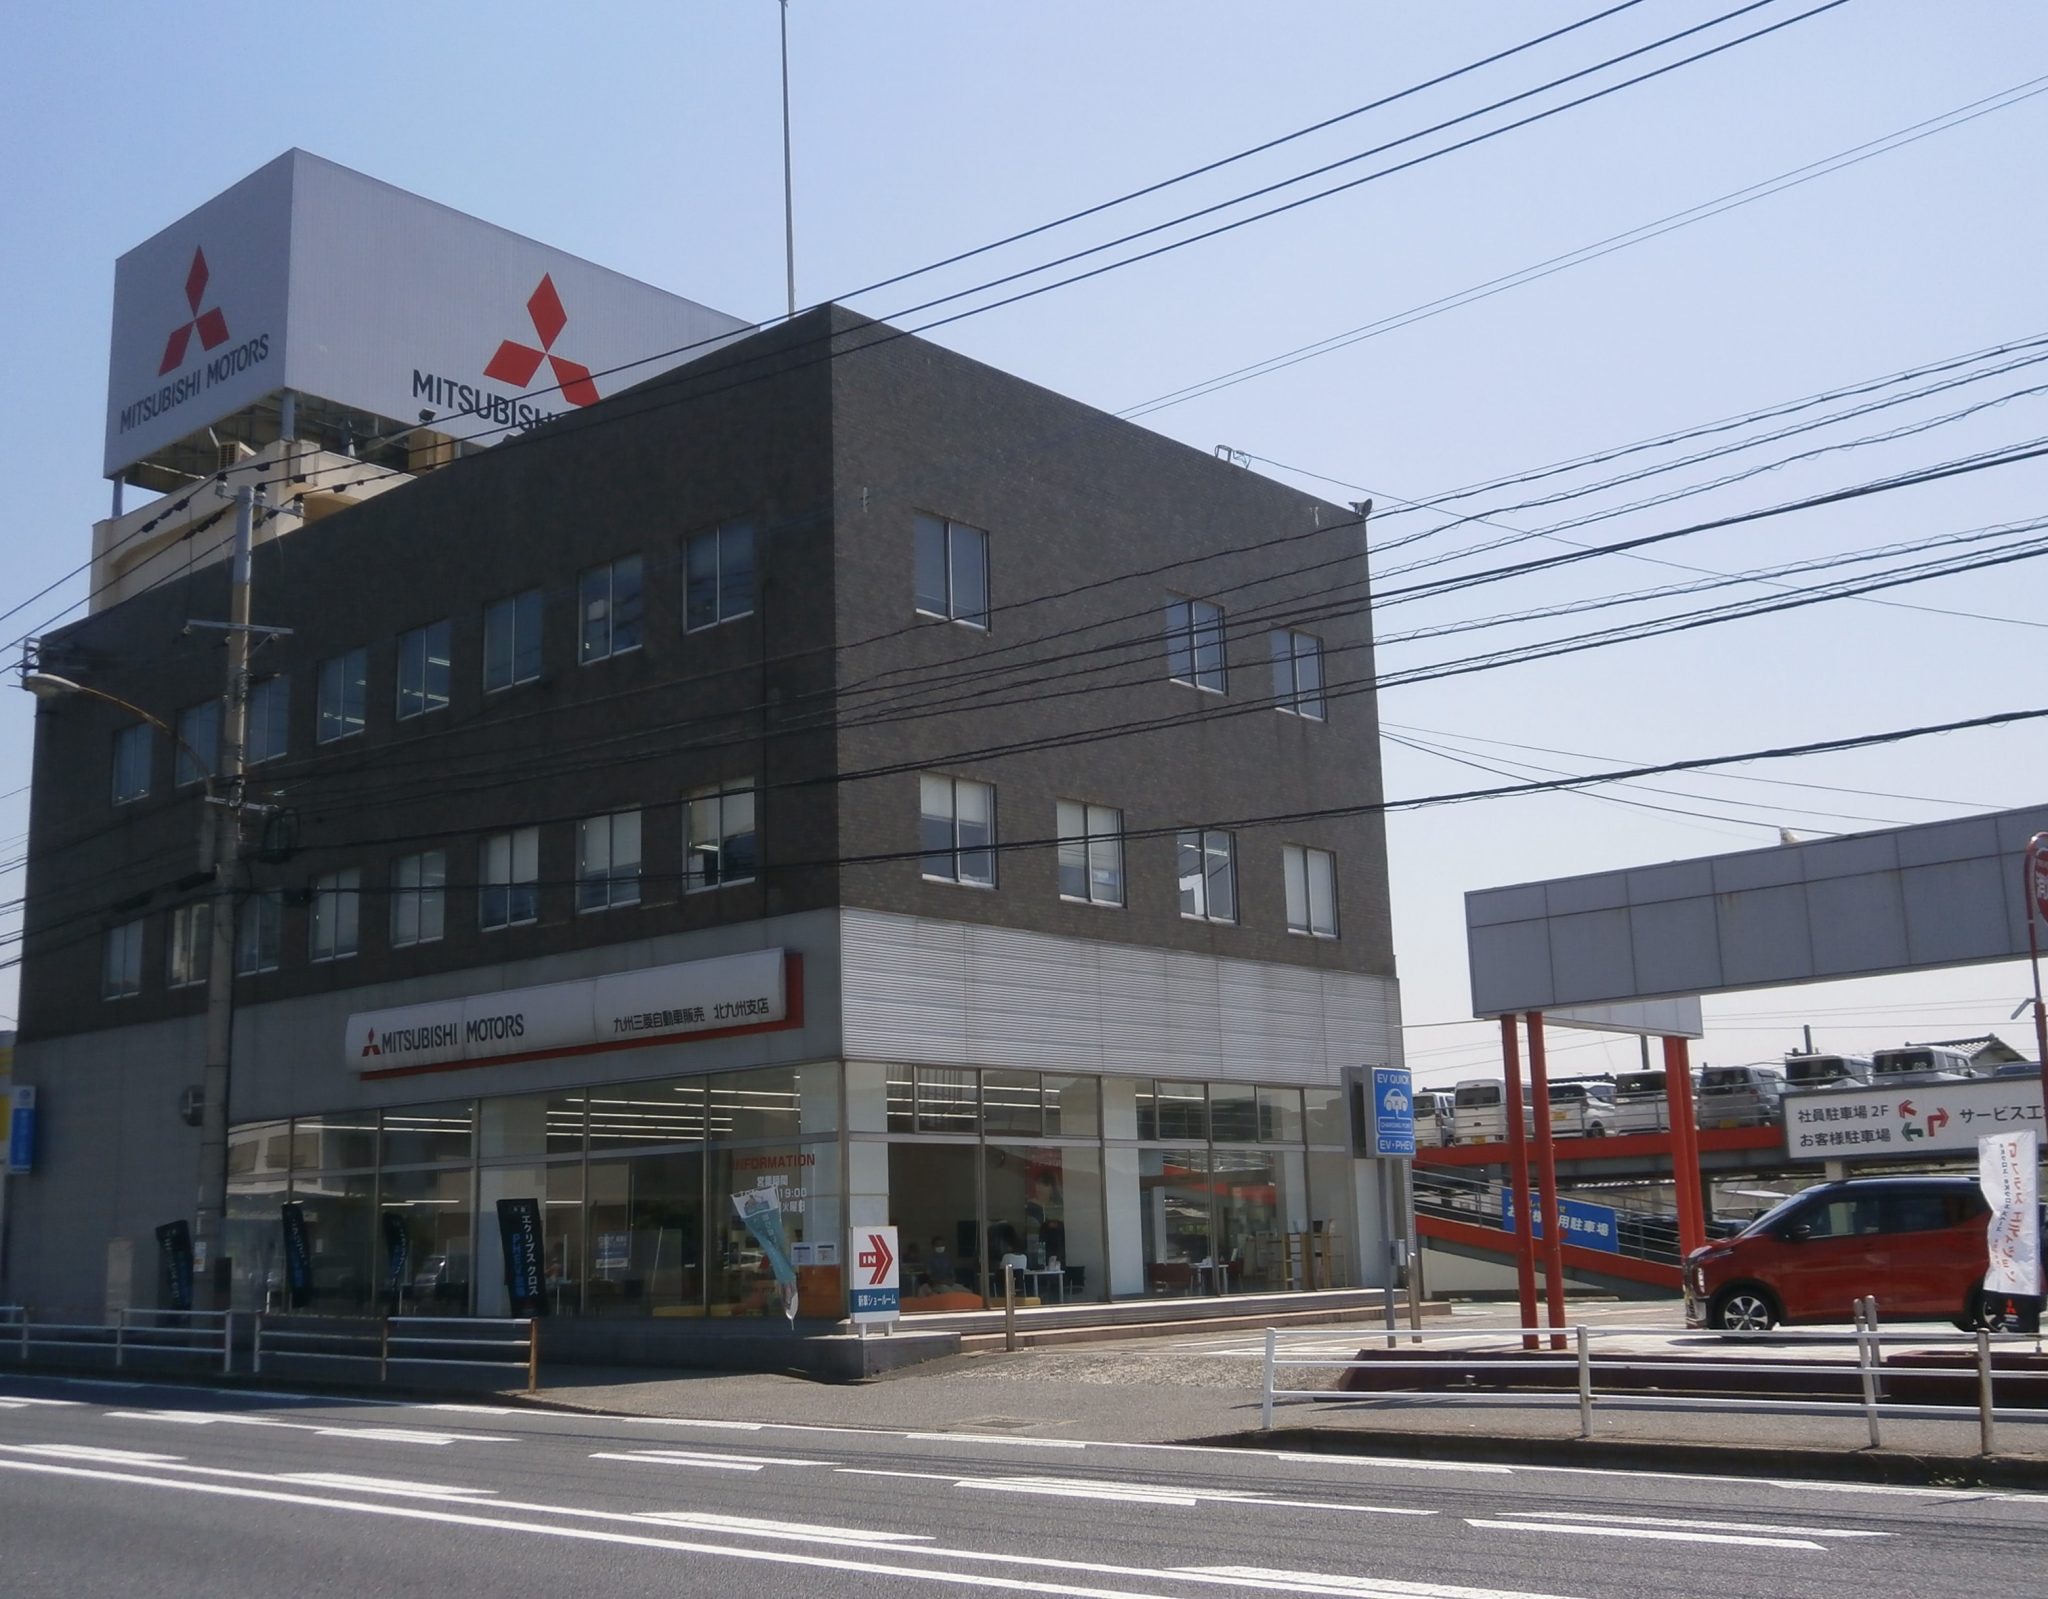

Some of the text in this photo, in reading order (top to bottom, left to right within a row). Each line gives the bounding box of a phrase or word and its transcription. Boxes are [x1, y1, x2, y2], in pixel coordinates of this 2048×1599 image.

[119, 334, 269, 435] MITSUBISHI MOTORS
[613, 998, 770, 1034] 九州三菱自動車販売 北九州支店
[381, 1013, 525, 1054] MITSUBISHI MOTORS
[1377, 1073, 1410, 1085] EV QUICK
[1798, 1105, 1889, 1123] 社員駐車場 2F
[1800, 1129, 1891, 1147] お客様駐車場
[731, 1154, 815, 1171] INFORMATION
[521, 1215, 539, 1296] エクリプス クロス
[862, 1255, 877, 1264] IN
[858, 1294, 896, 1307] 新車ショールーム
